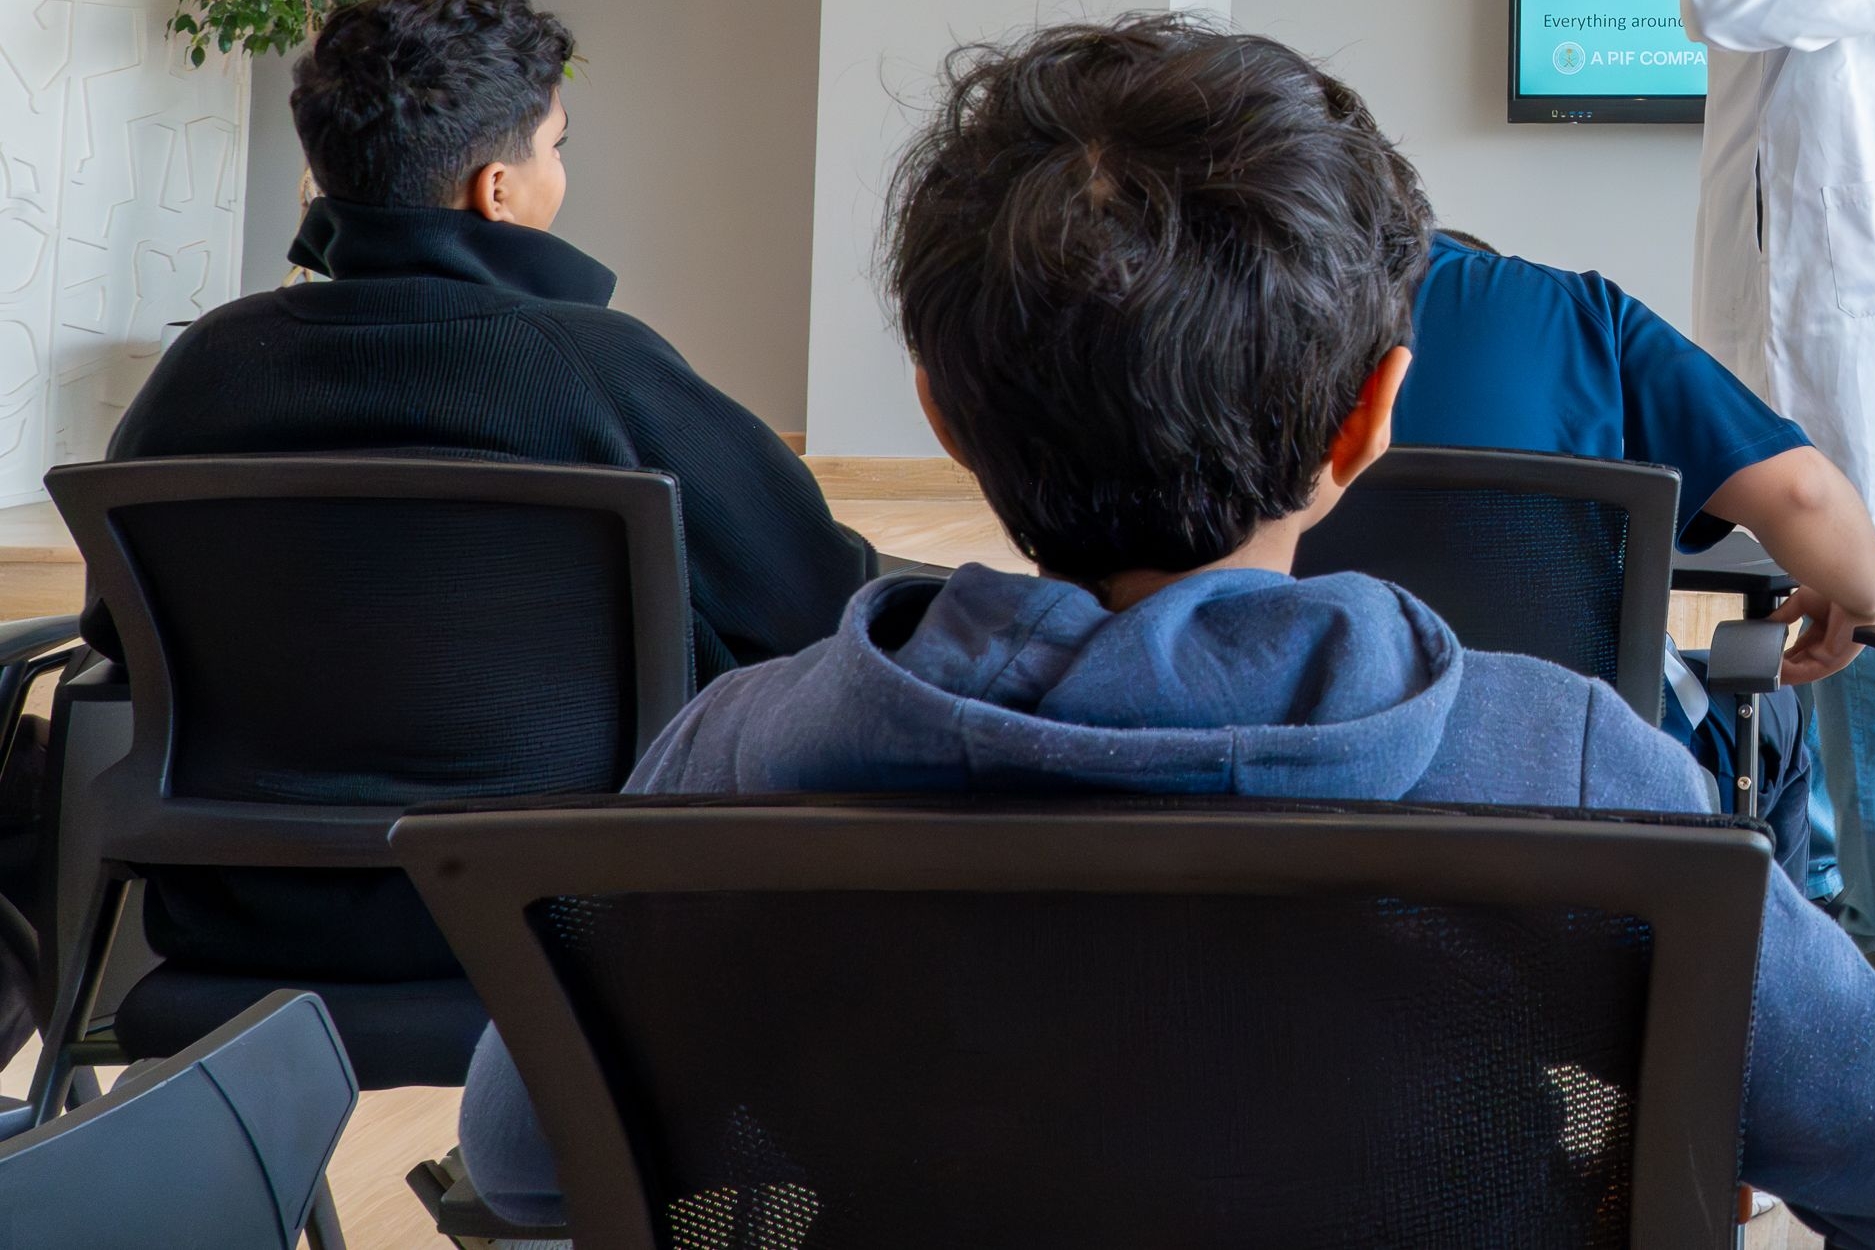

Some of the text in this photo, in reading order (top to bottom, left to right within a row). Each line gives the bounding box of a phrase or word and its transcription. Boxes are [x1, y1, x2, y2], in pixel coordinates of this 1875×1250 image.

[1544, 13, 1627, 31] Everything
[1590, 51, 1707, 66] A PIF COMPA
